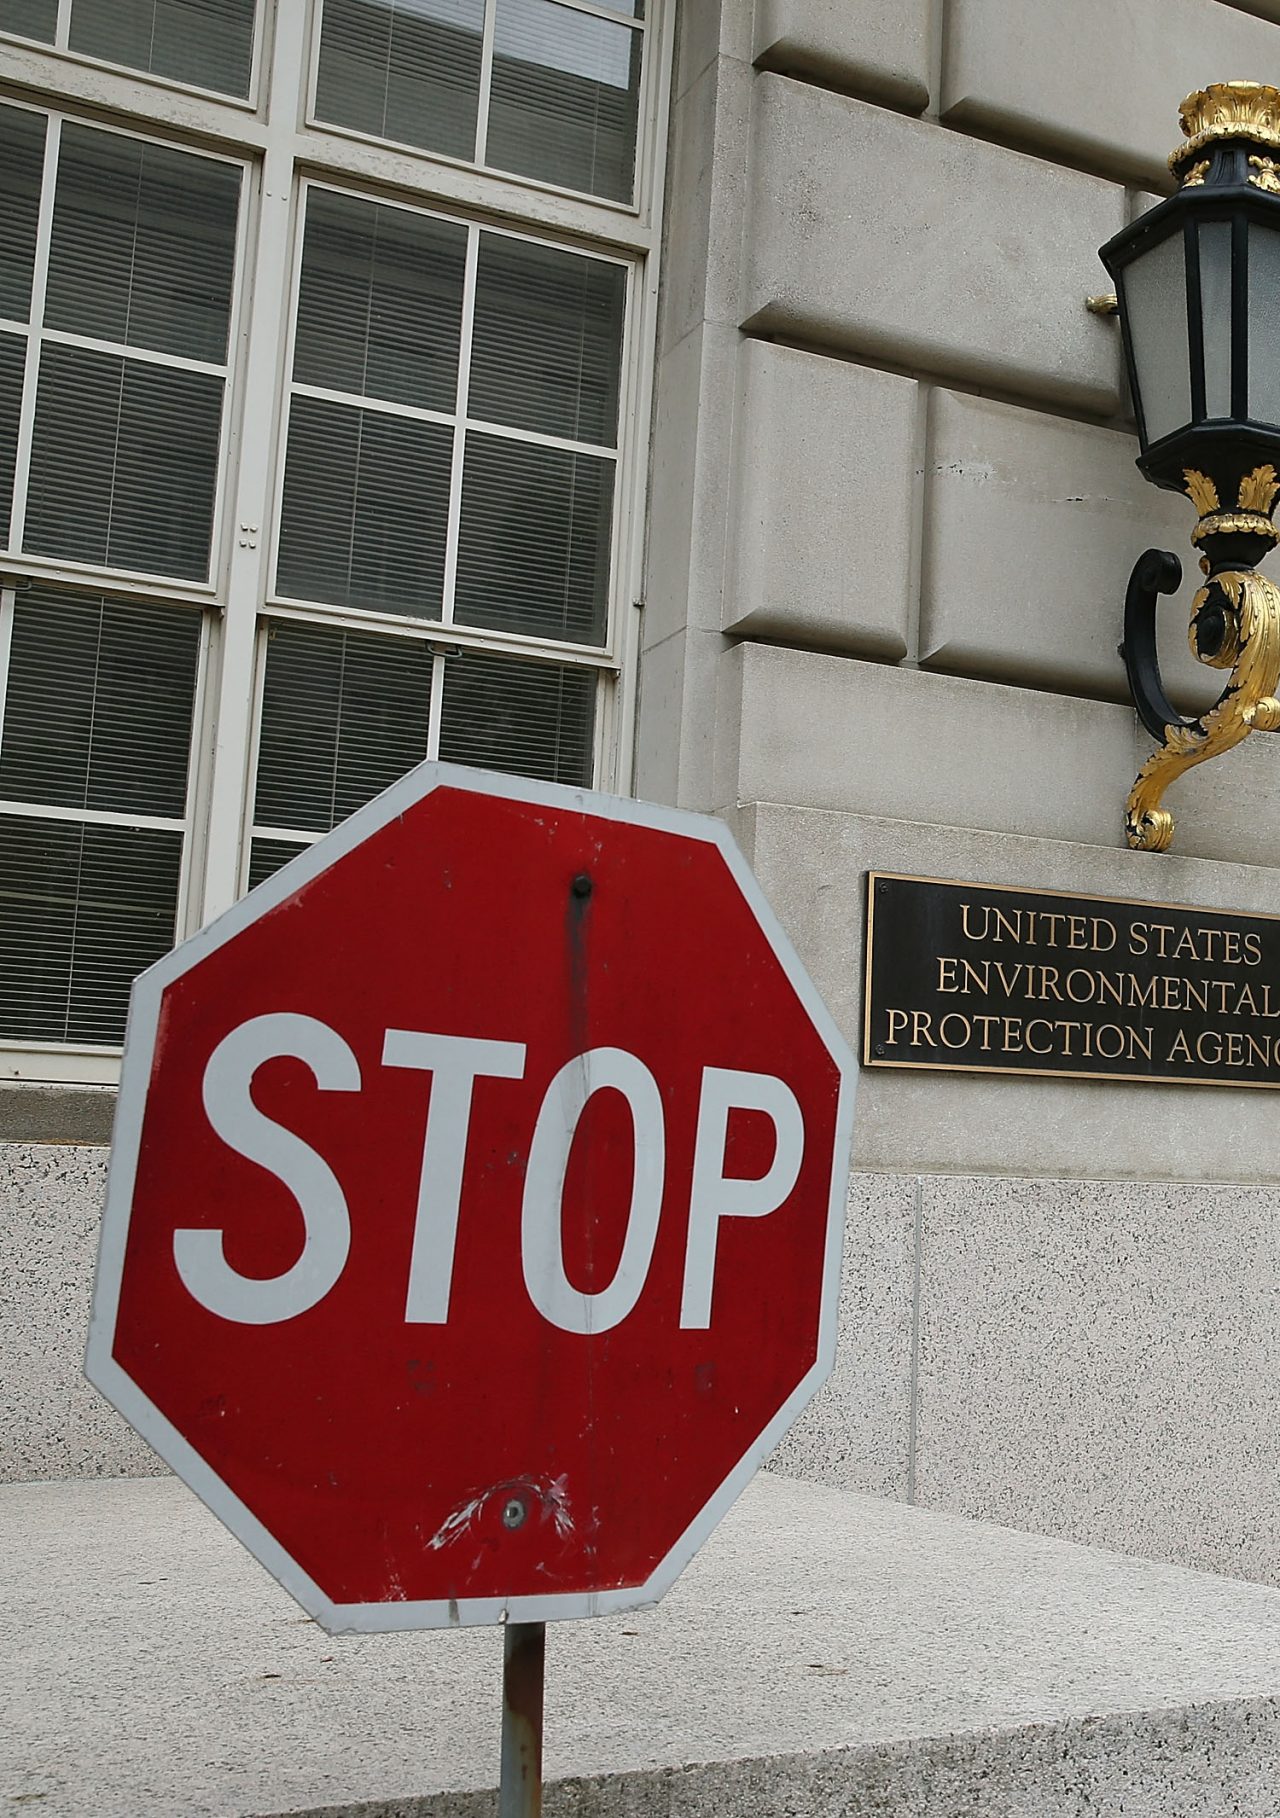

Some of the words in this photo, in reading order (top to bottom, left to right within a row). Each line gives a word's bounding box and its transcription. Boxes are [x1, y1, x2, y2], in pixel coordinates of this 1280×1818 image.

[959, 903, 1118, 953] UNITED
[1128, 921, 1263, 966] STATES
[935, 957, 1280, 1019] ENVIRONMENTAL
[884, 1008, 1155, 1060] PROTECTION
[172, 1011, 806, 1336] STOP
